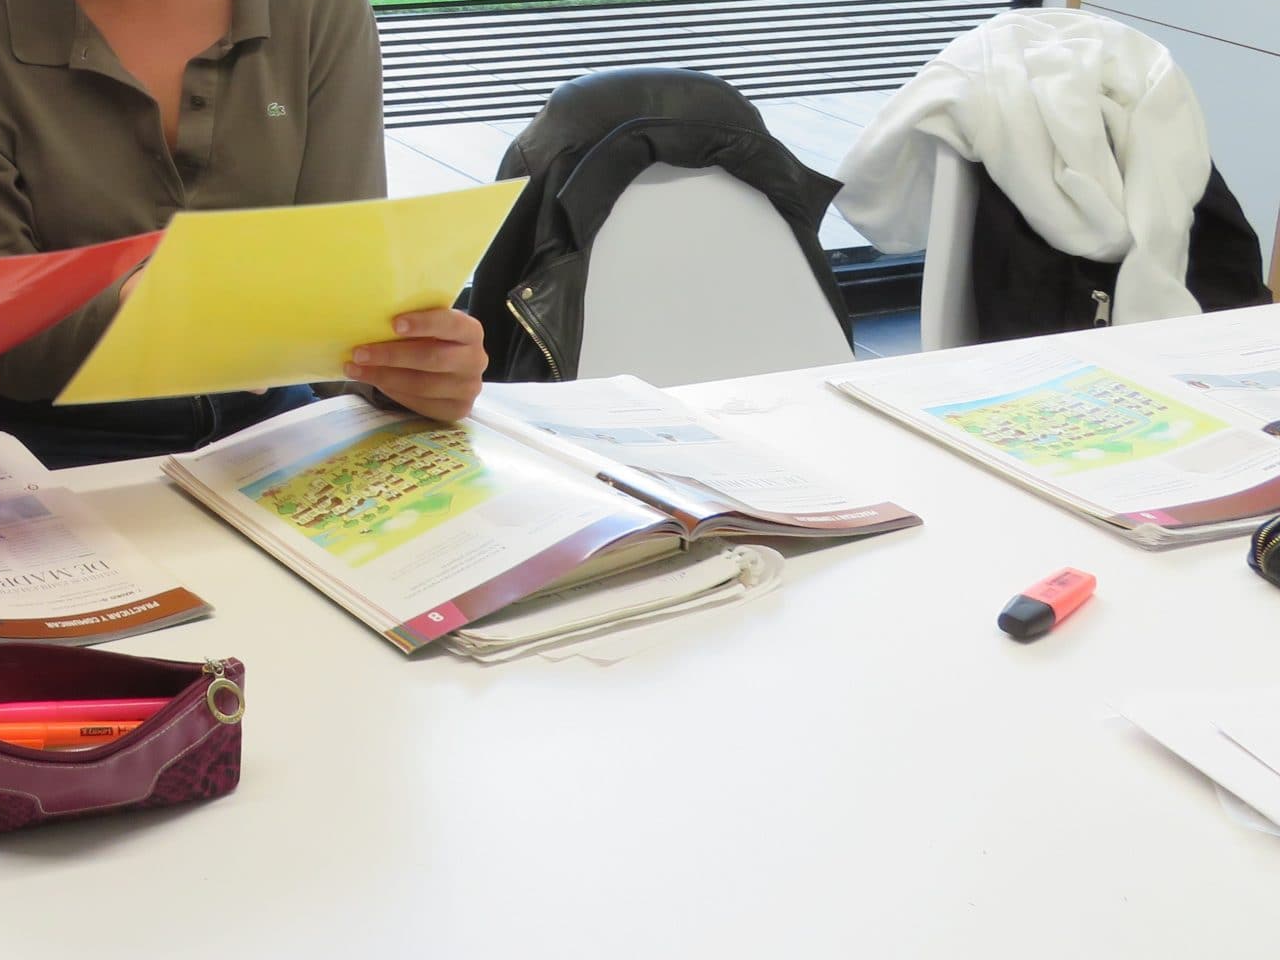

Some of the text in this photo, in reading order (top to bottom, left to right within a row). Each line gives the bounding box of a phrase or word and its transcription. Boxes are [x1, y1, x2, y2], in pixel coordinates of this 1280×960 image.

[75, 559, 111, 575] DE
[111, 600, 160, 622] PRACTICAR
[427, 612, 445, 622] 8
[45, 615, 100, 629] COMUNICAR
[100, 613, 111, 624] Y
